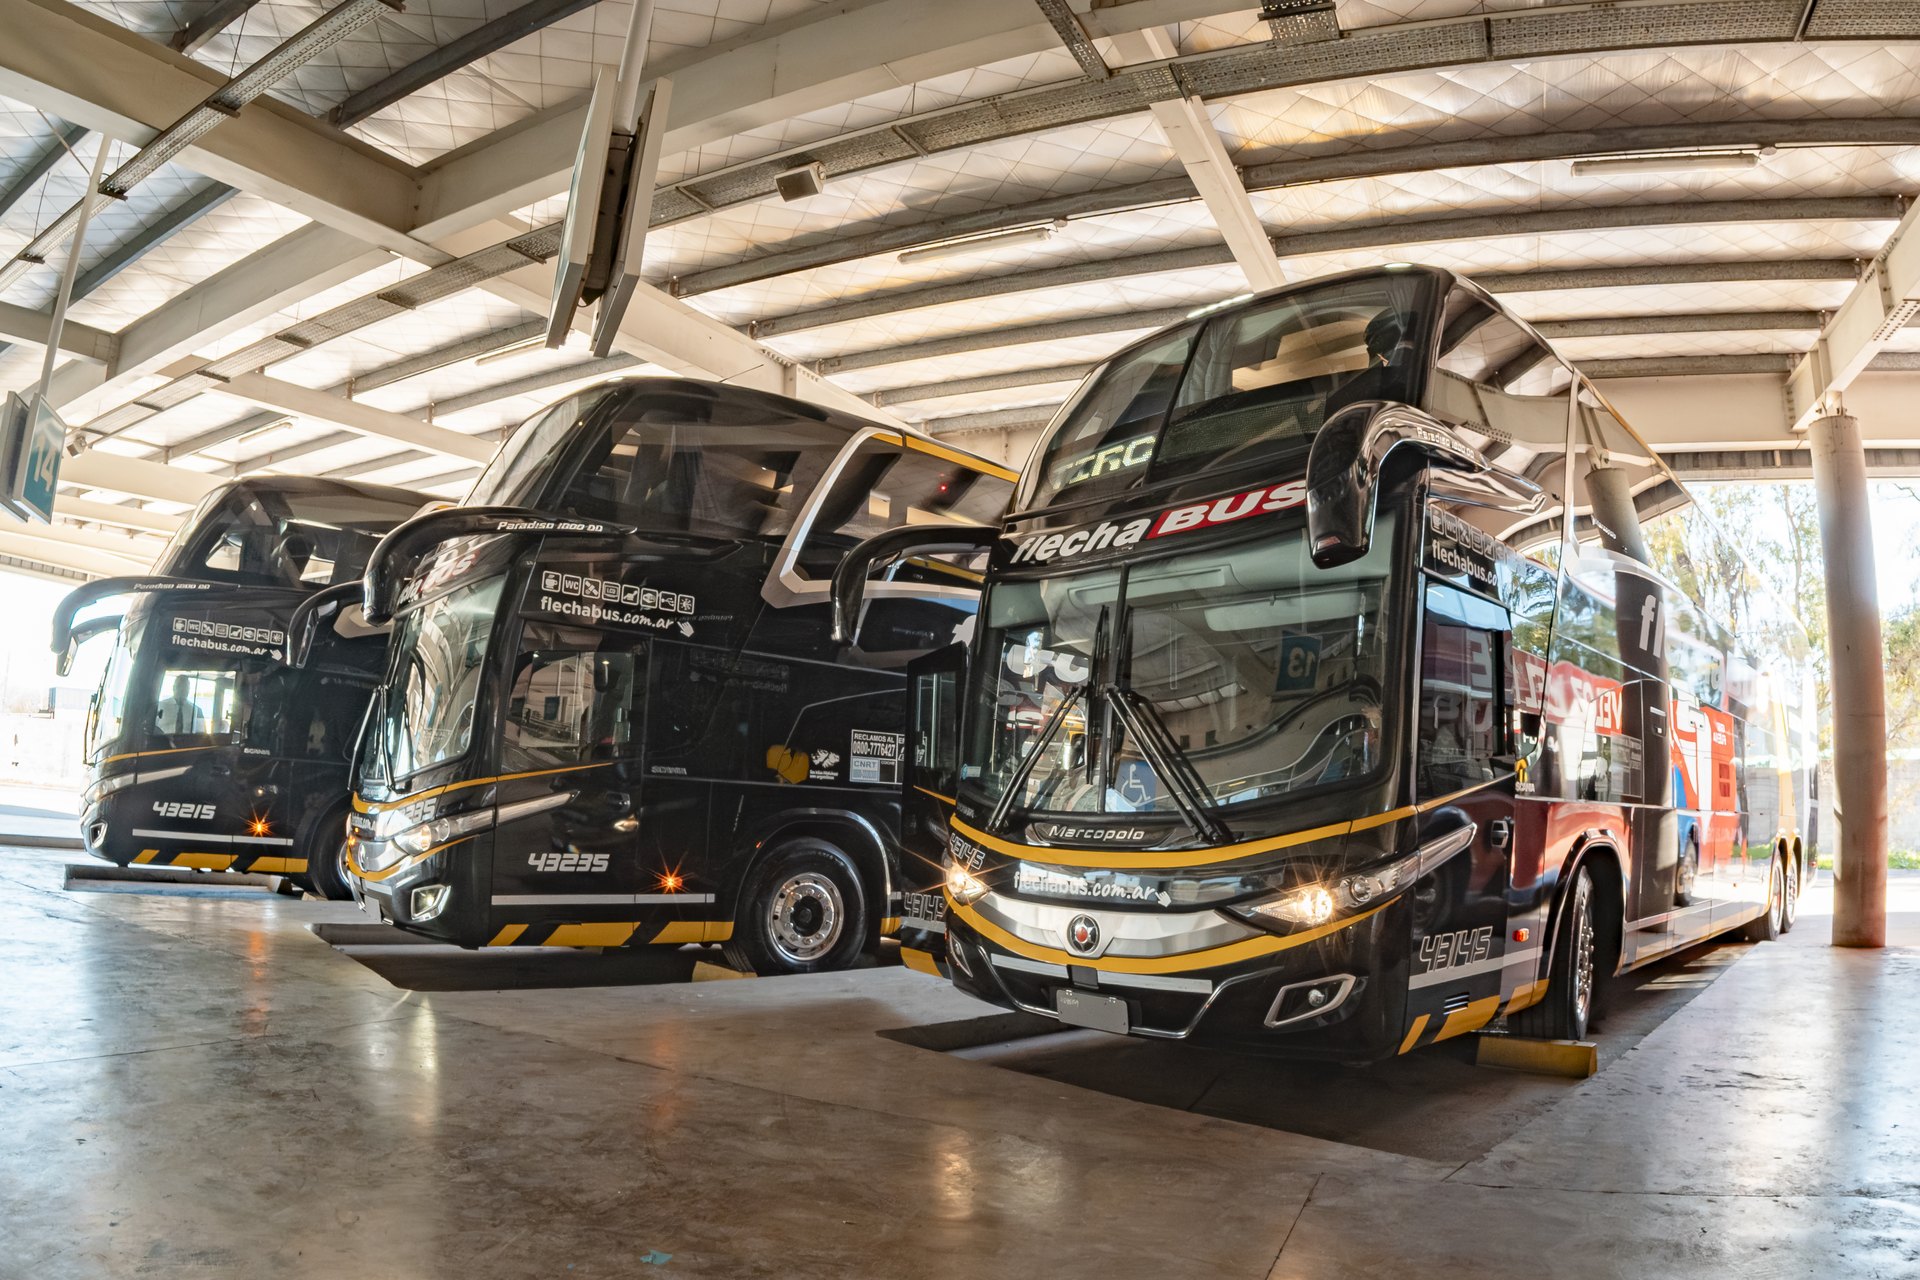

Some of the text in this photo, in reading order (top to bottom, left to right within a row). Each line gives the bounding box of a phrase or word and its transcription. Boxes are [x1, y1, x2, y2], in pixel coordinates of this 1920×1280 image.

[33, 433, 57, 493] 14
[496, 521, 555, 531] Paradiso
[586, 524, 604, 532] DD
[565, 579, 579, 590] WC
[540, 595, 675, 630] flechabus.com.ar
[172, 634, 268, 656] flechabus.com.ar
[854, 732, 895, 744] RECLAMOS AL
[853, 760, 877, 769] CNRT
[152, 801, 217, 820] 43215
[1048, 825, 1146, 842] Marcopolo
[950, 832, 986, 870] 43145
[527, 853, 611, 873] 43235
[1419, 925, 1494, 974] 43145
